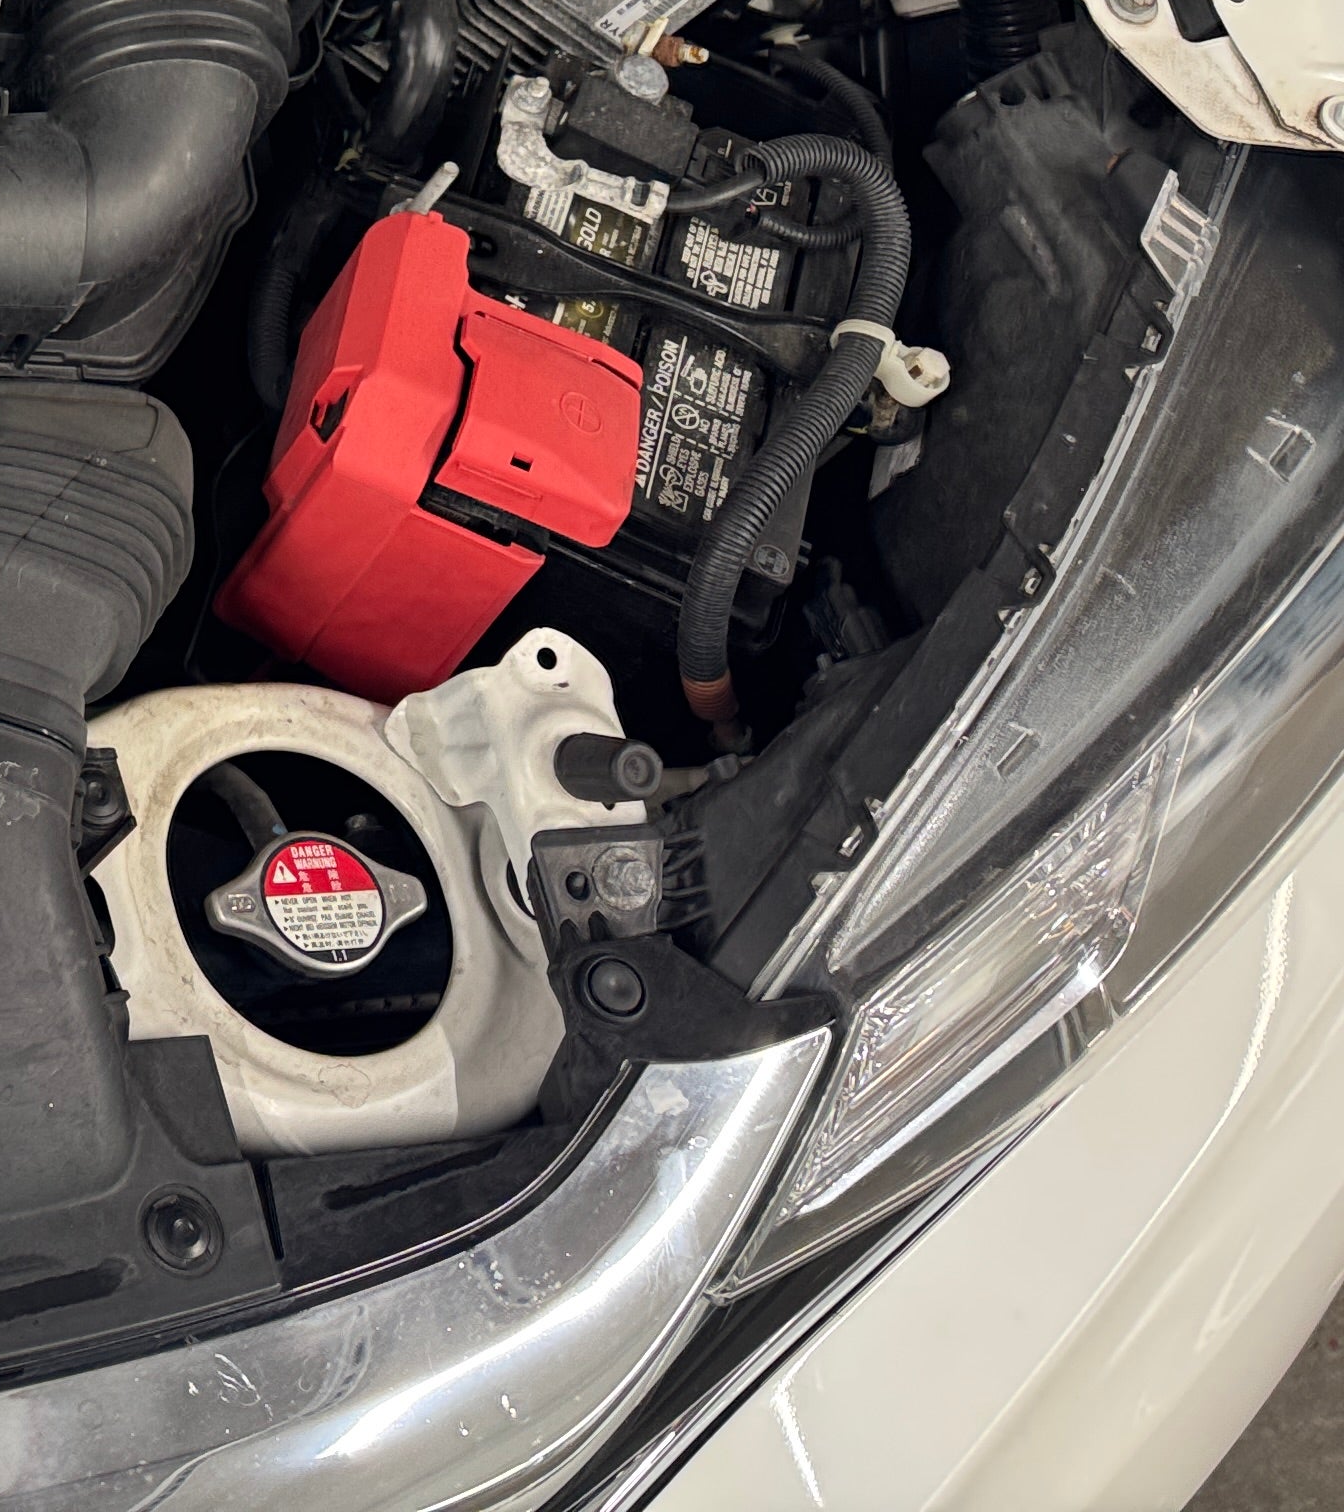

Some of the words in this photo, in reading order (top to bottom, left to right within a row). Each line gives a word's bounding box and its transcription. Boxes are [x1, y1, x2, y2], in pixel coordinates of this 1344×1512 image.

[576, 206, 602, 252] GOLD
[636, 408, 664, 473] DANGER
[654, 339, 681, 397] POISON
[677, 448, 691, 471] EYES
[290, 844, 334, 859] DANGER
[332, 949, 348, 961] 1.1
